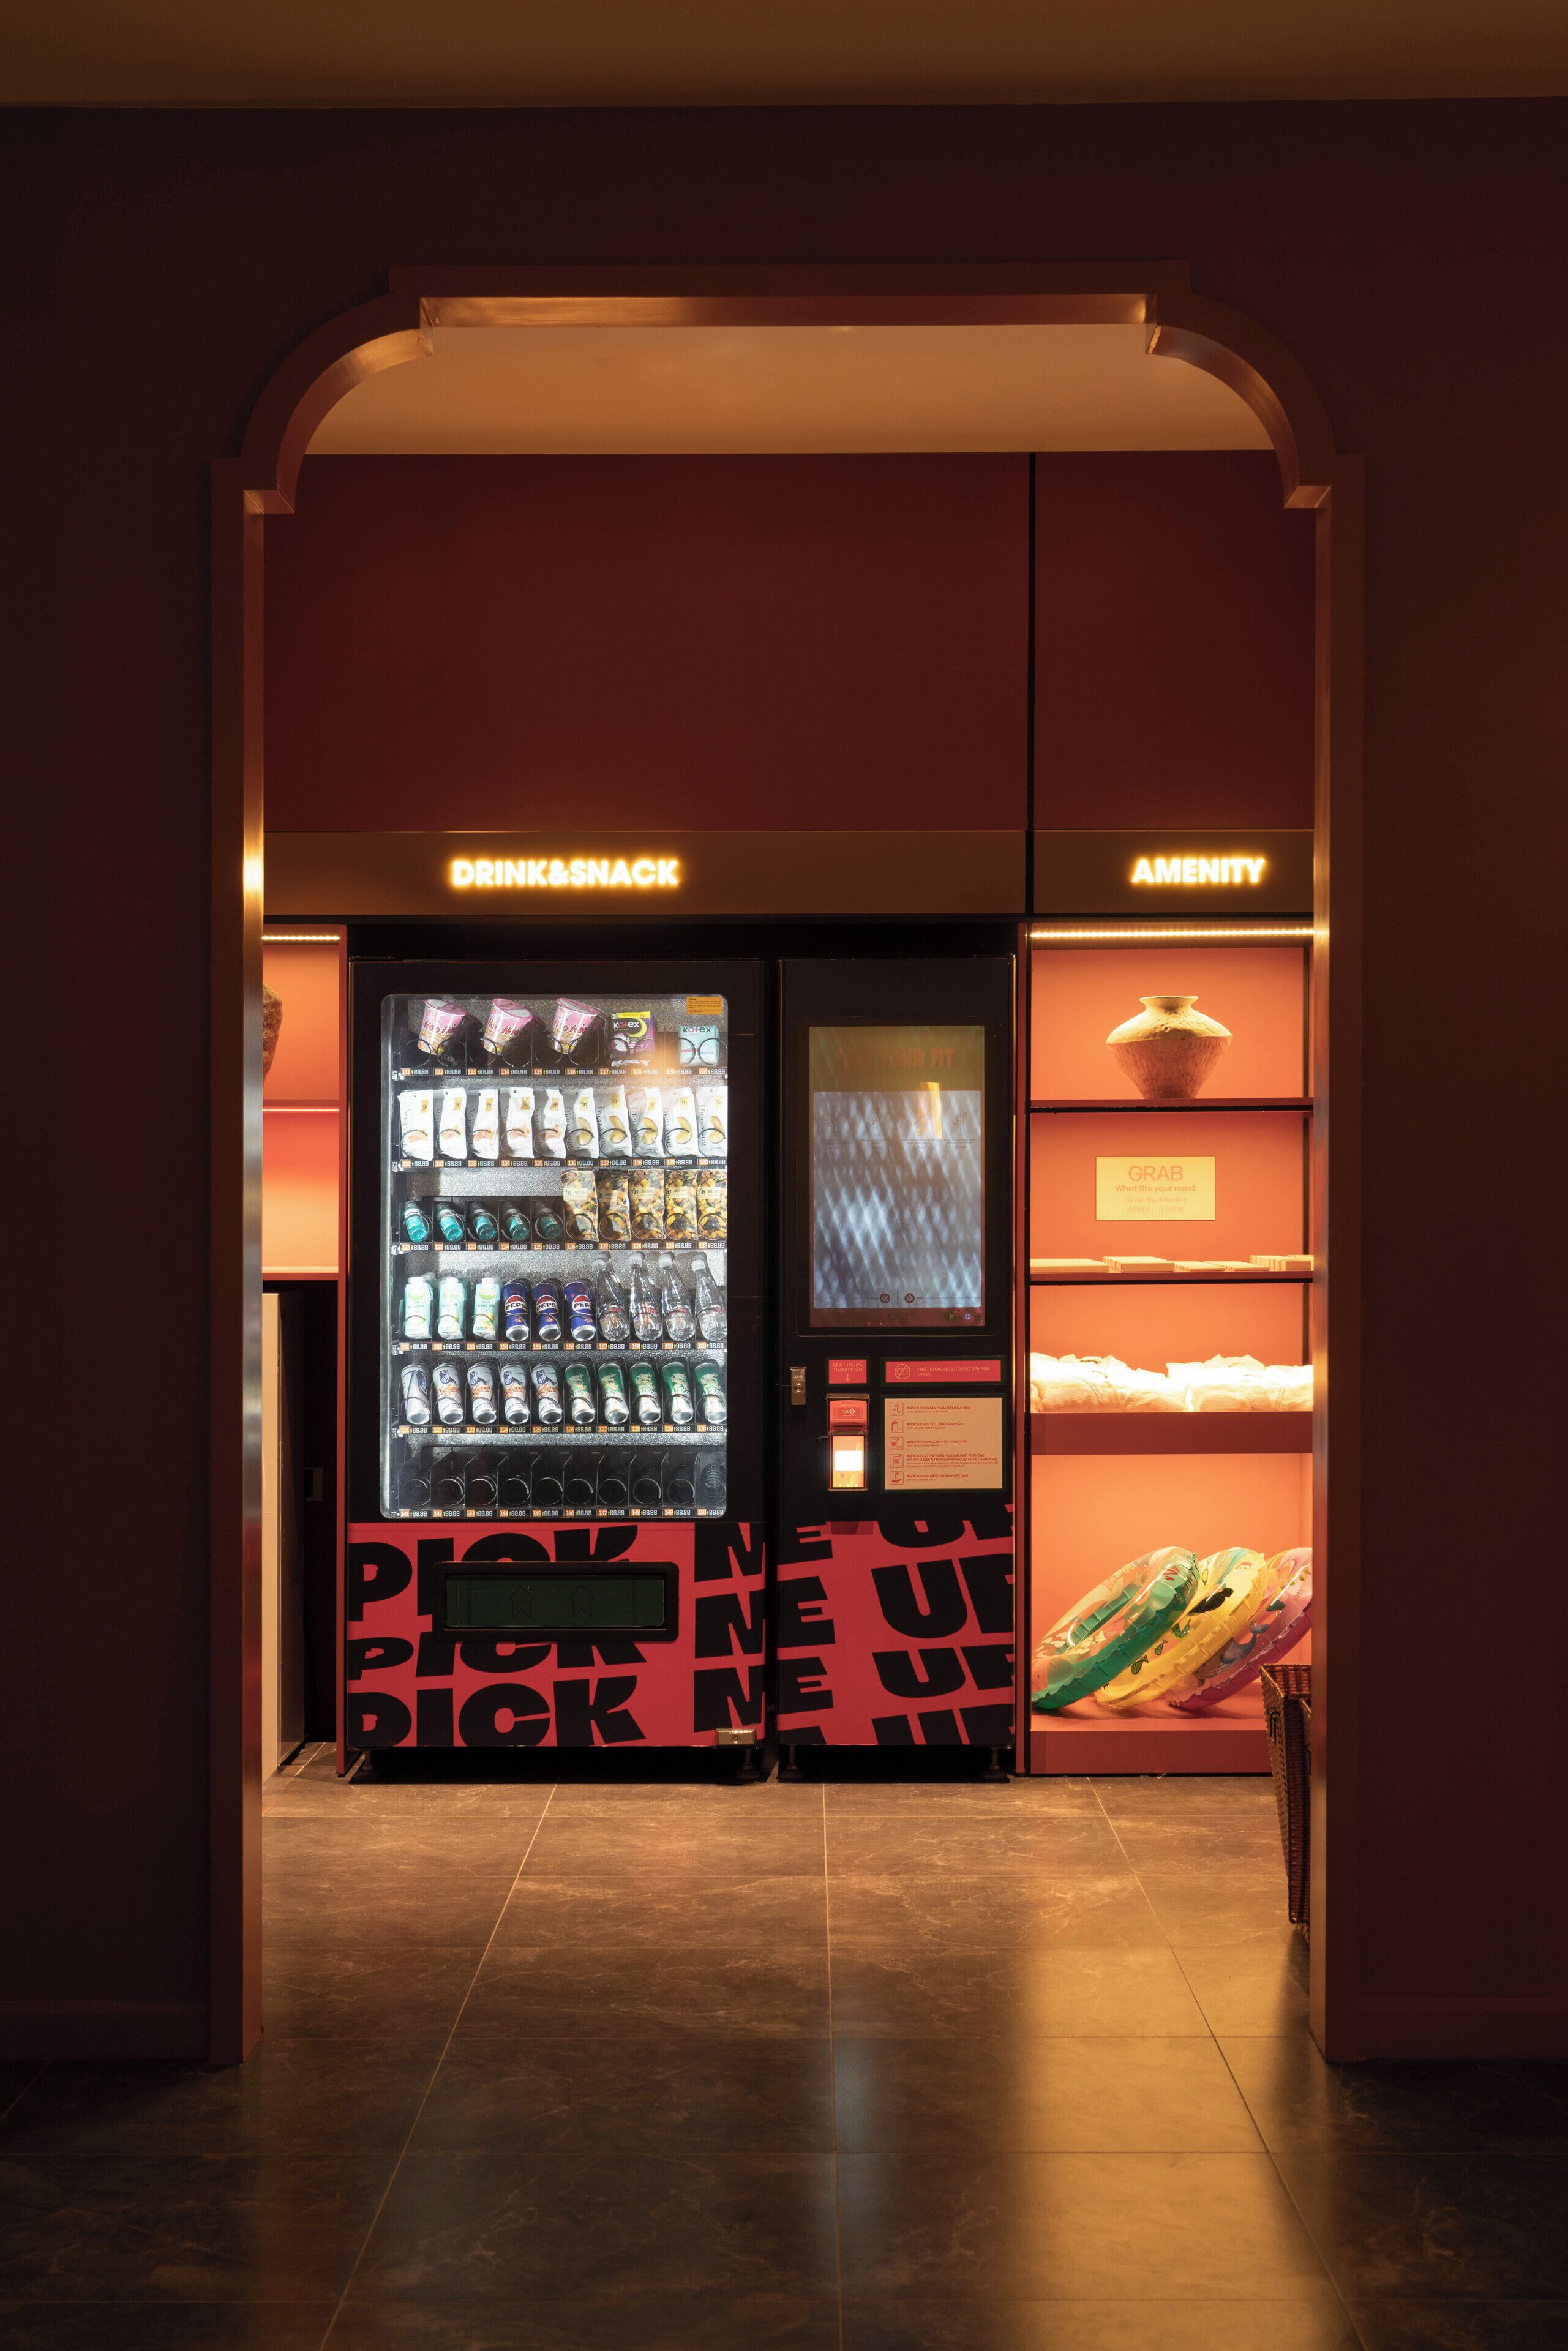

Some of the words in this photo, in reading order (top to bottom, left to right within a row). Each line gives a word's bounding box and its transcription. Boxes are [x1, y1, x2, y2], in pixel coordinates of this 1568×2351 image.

[452, 859, 680, 887] DRINK&SNACK
[1131, 857, 1266, 884] AMENITY
[1128, 1165, 1184, 1182] GRAB
